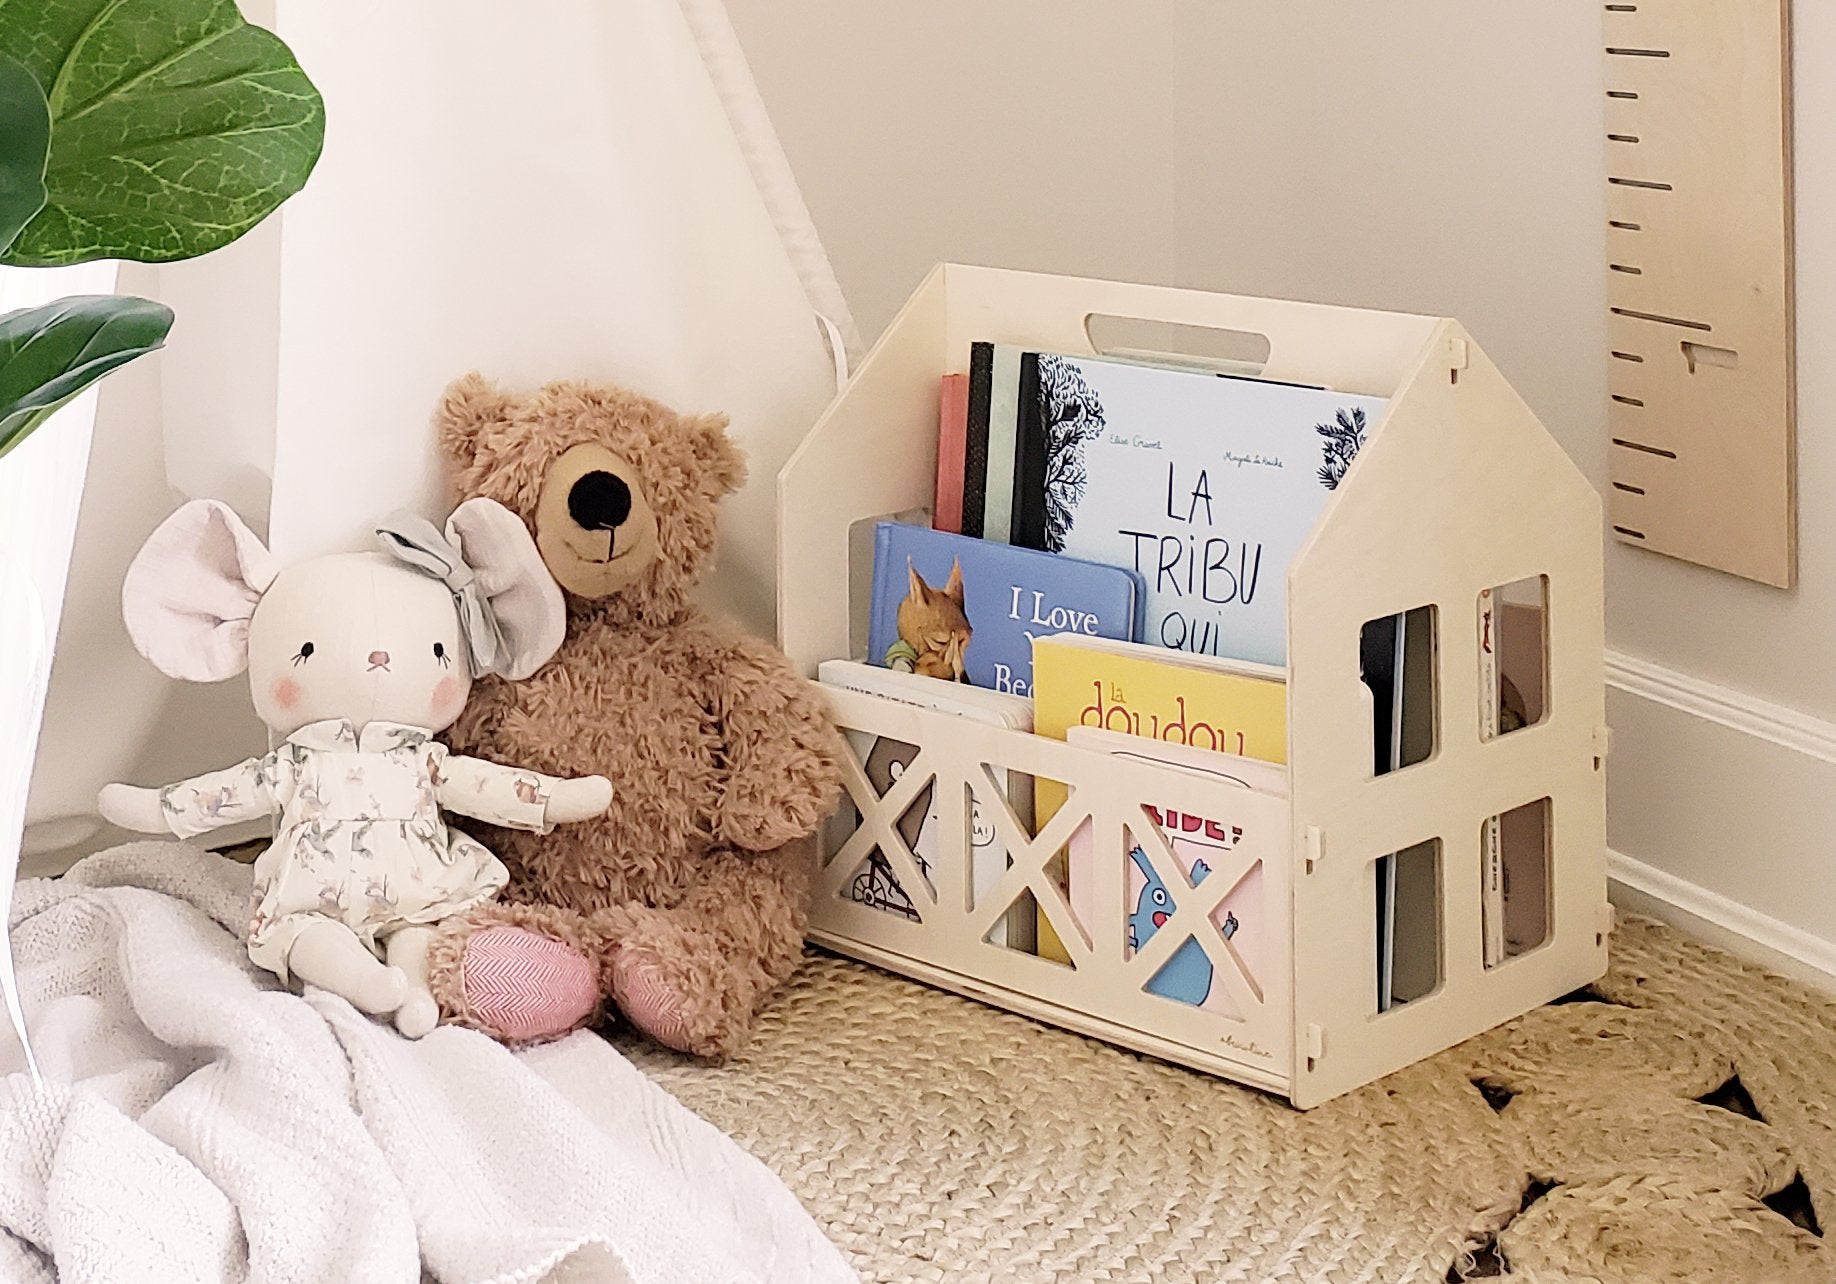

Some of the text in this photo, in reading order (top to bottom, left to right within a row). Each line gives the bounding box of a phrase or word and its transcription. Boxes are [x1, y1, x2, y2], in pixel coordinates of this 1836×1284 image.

[1167, 461, 1213, 526] LA
[1009, 586, 1099, 635] I Love
[994, 663, 1034, 698] Be
[1111, 682, 1126, 703] la
